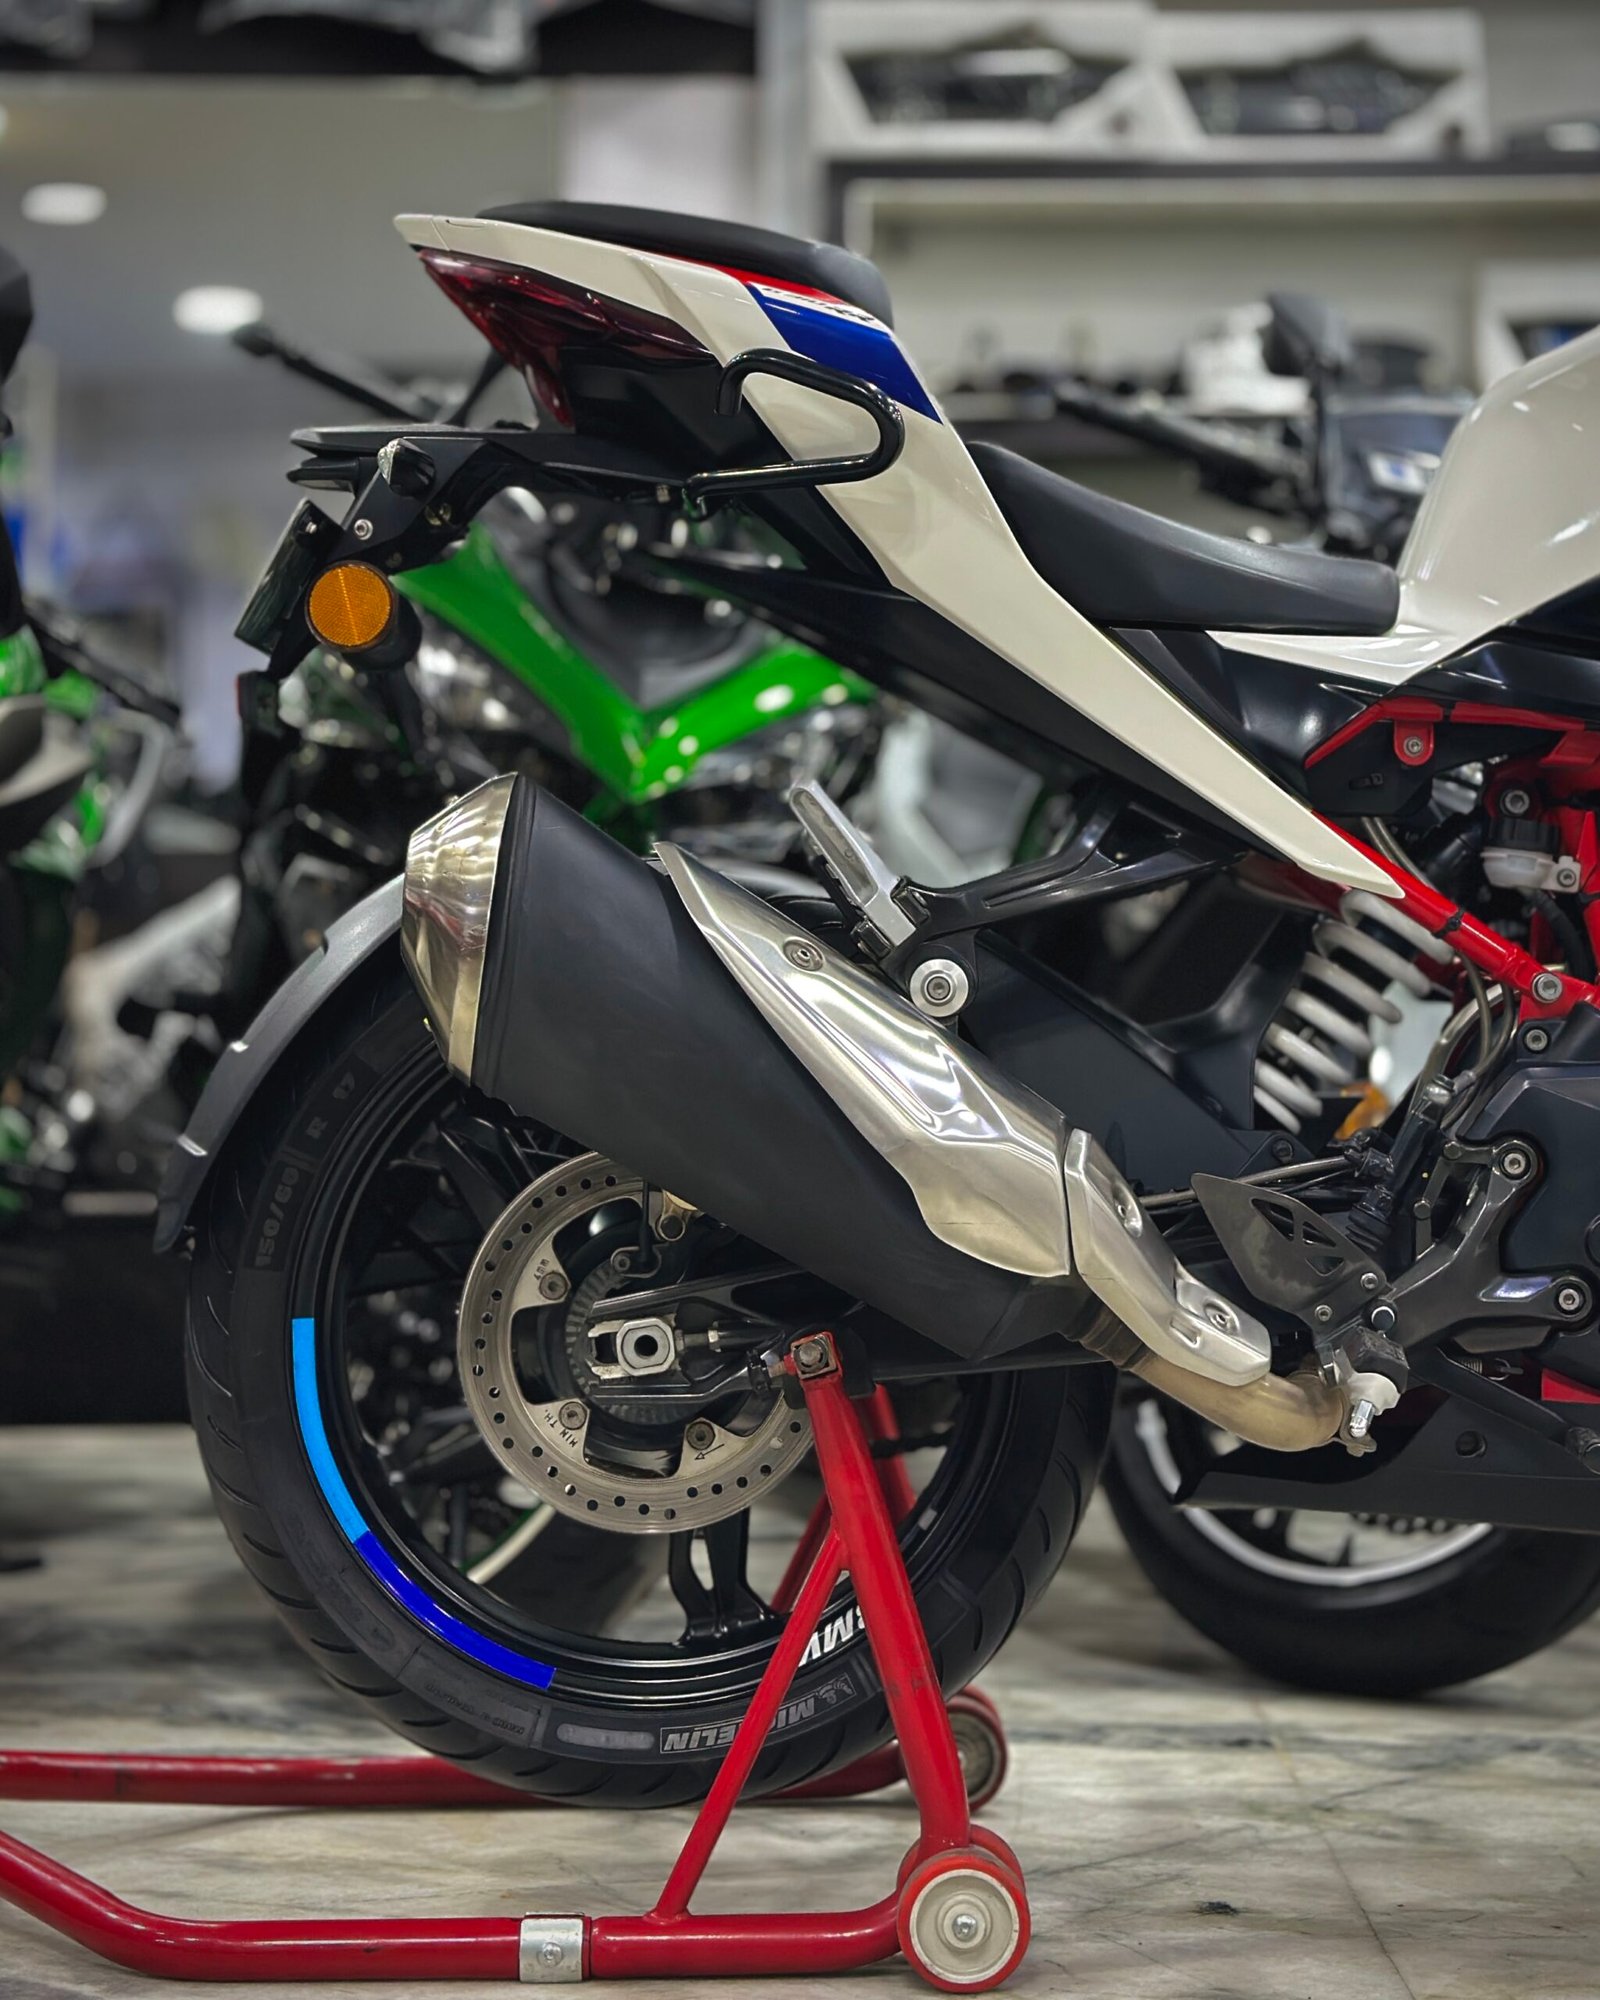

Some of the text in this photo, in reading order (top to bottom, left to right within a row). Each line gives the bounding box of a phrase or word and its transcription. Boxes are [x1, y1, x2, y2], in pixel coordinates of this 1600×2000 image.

[305, 1115, 328, 1139] R
[559, 1428, 578, 1447] MIN
[663, 1697, 815, 1750] MIELIN
